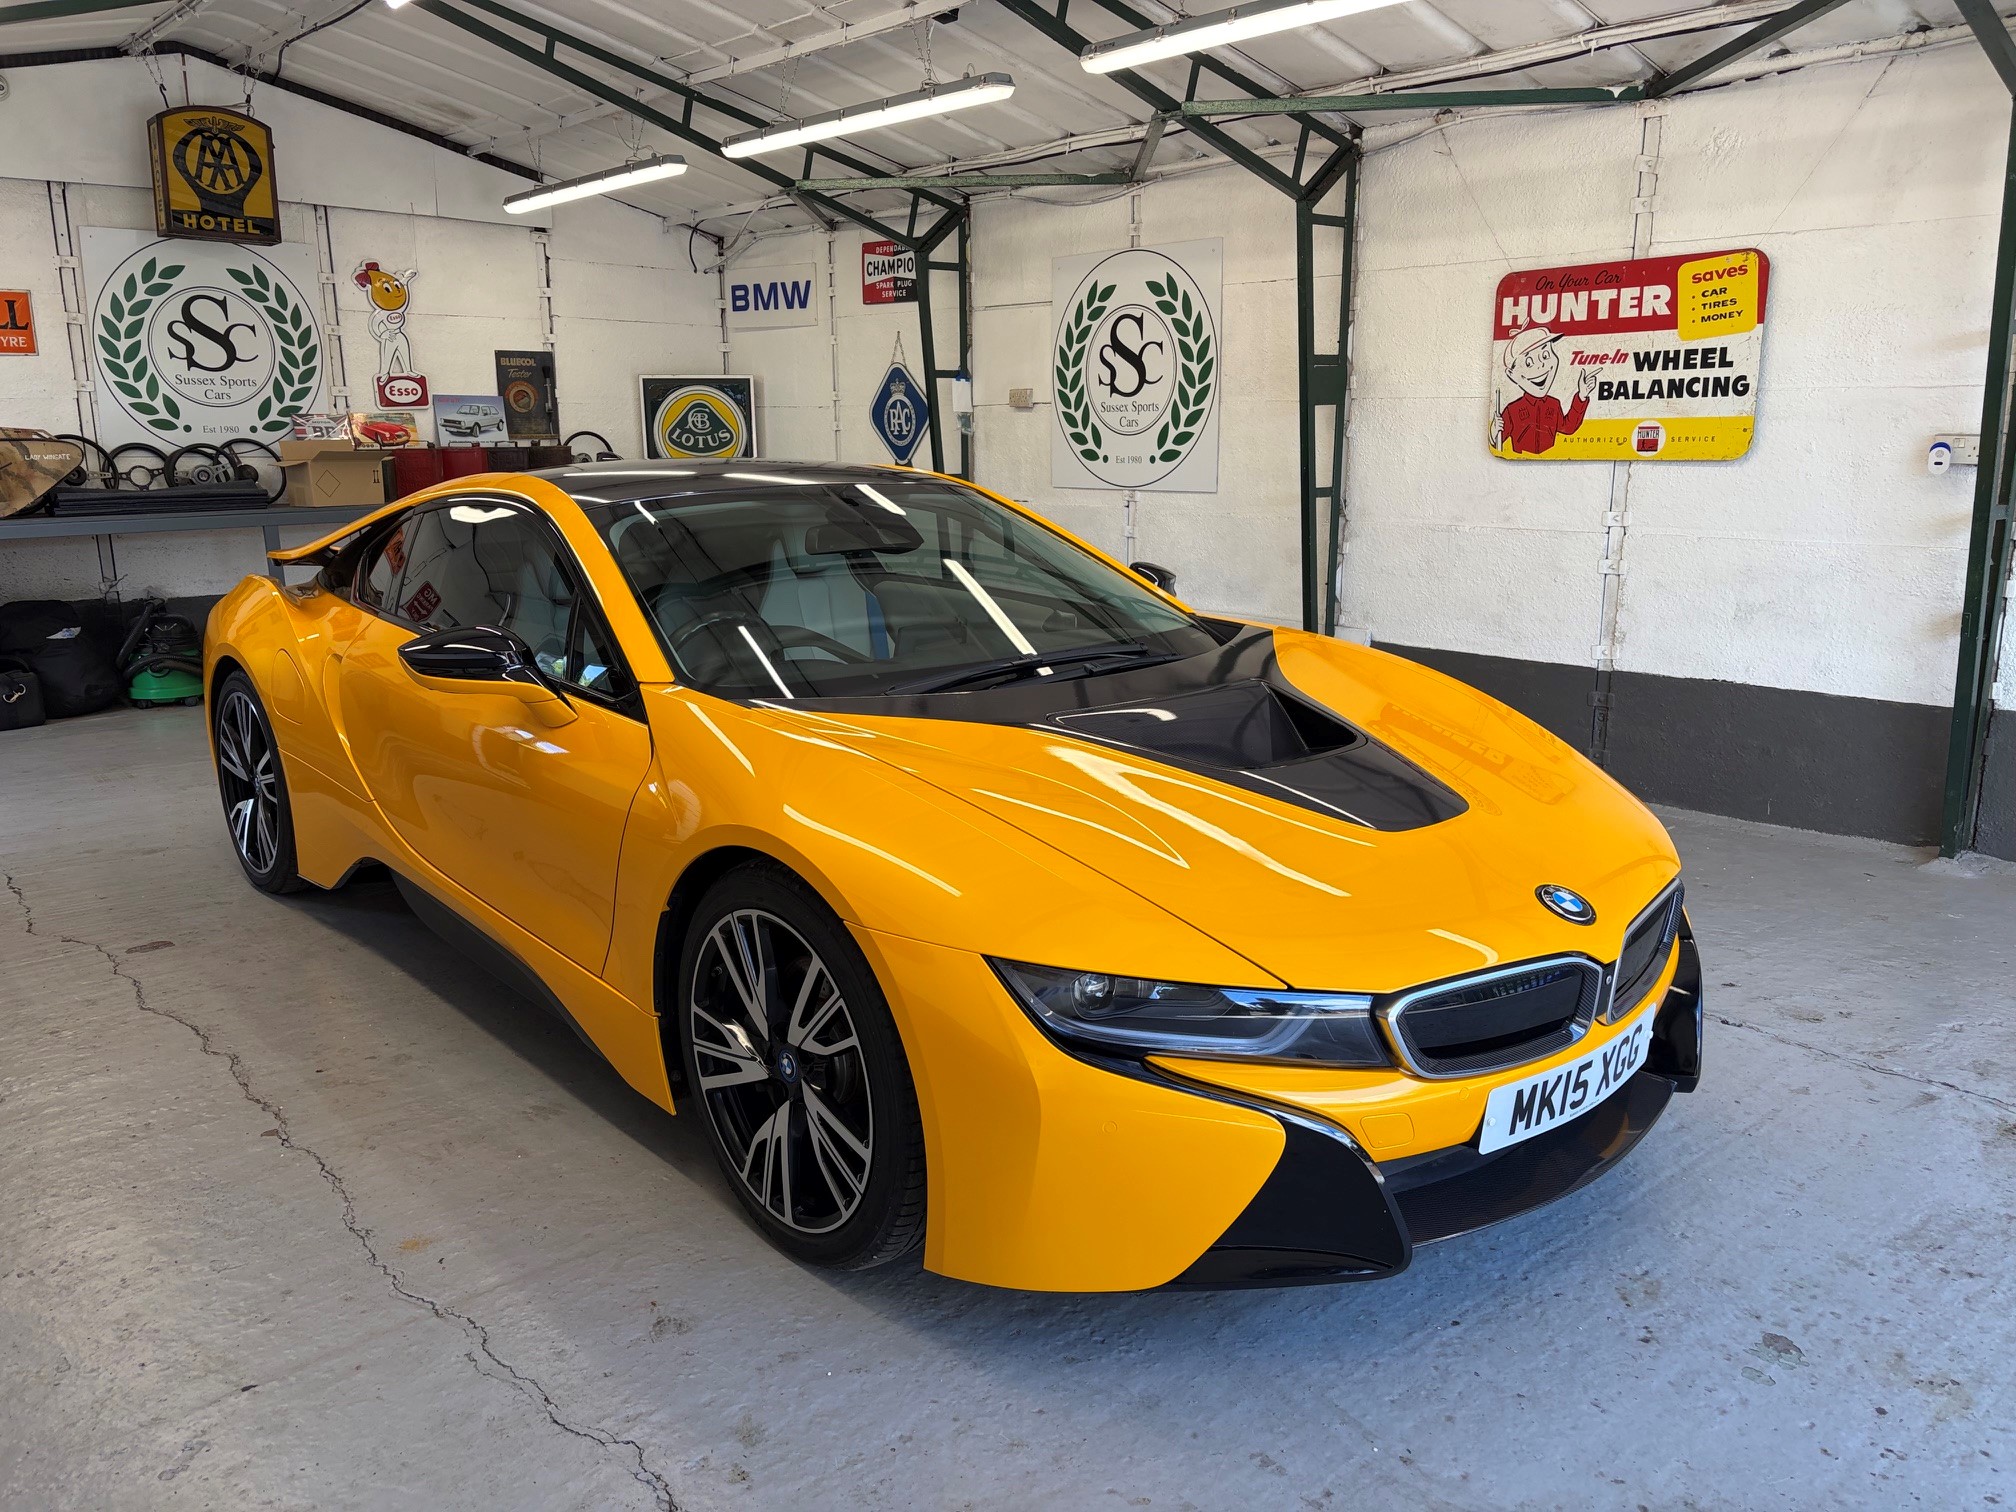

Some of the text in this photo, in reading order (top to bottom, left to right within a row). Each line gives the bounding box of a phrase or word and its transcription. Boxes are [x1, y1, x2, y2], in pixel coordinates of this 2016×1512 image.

[183, 213, 260, 235] HOTEL
[876, 244, 909, 254] DEPENDAB
[866, 257, 914, 277] CHAMPIO
[1692, 263, 1748, 284] saves
[876, 279, 912, 290] SPARK PLUG
[1535, 275, 1555, 291] On
[1558, 273, 1589, 292] Your
[730, 280, 811, 312] BMW
[882, 289, 907, 298] SERVICE
[1701, 286, 1728, 299] CAR
[1501, 284, 1672, 327] HUNTER
[1701, 298, 1738, 310] TIRES
[0, 299, 29, 331] L
[1700, 309, 1744, 323] MONEY
[0, 336, 28, 348] YRE
[501, 357, 537, 367] BLUECOL
[1570, 346, 1734, 372] Tune-In WHEEL
[175, 373, 257, 389] Sussex Sports
[1597, 375, 1750, 401] BALANCING
[204, 388, 231, 400] Cars
[389, 385, 418, 396] Esso
[1100, 400, 1160, 414] Sussex Sports
[889, 400, 910, 435] RAC
[1119, 416, 1139, 428] Cars
[202, 424, 240, 434] Est 1980
[1637, 429, 1660, 439] HUNTER
[671, 427, 731, 448] LOTUS
[1563, 435, 1716, 444] AUTHORIZED SERVICE
[1115, 455, 1143, 464] Est 1980
[1508, 1023, 1644, 1136] MK15 XGG
